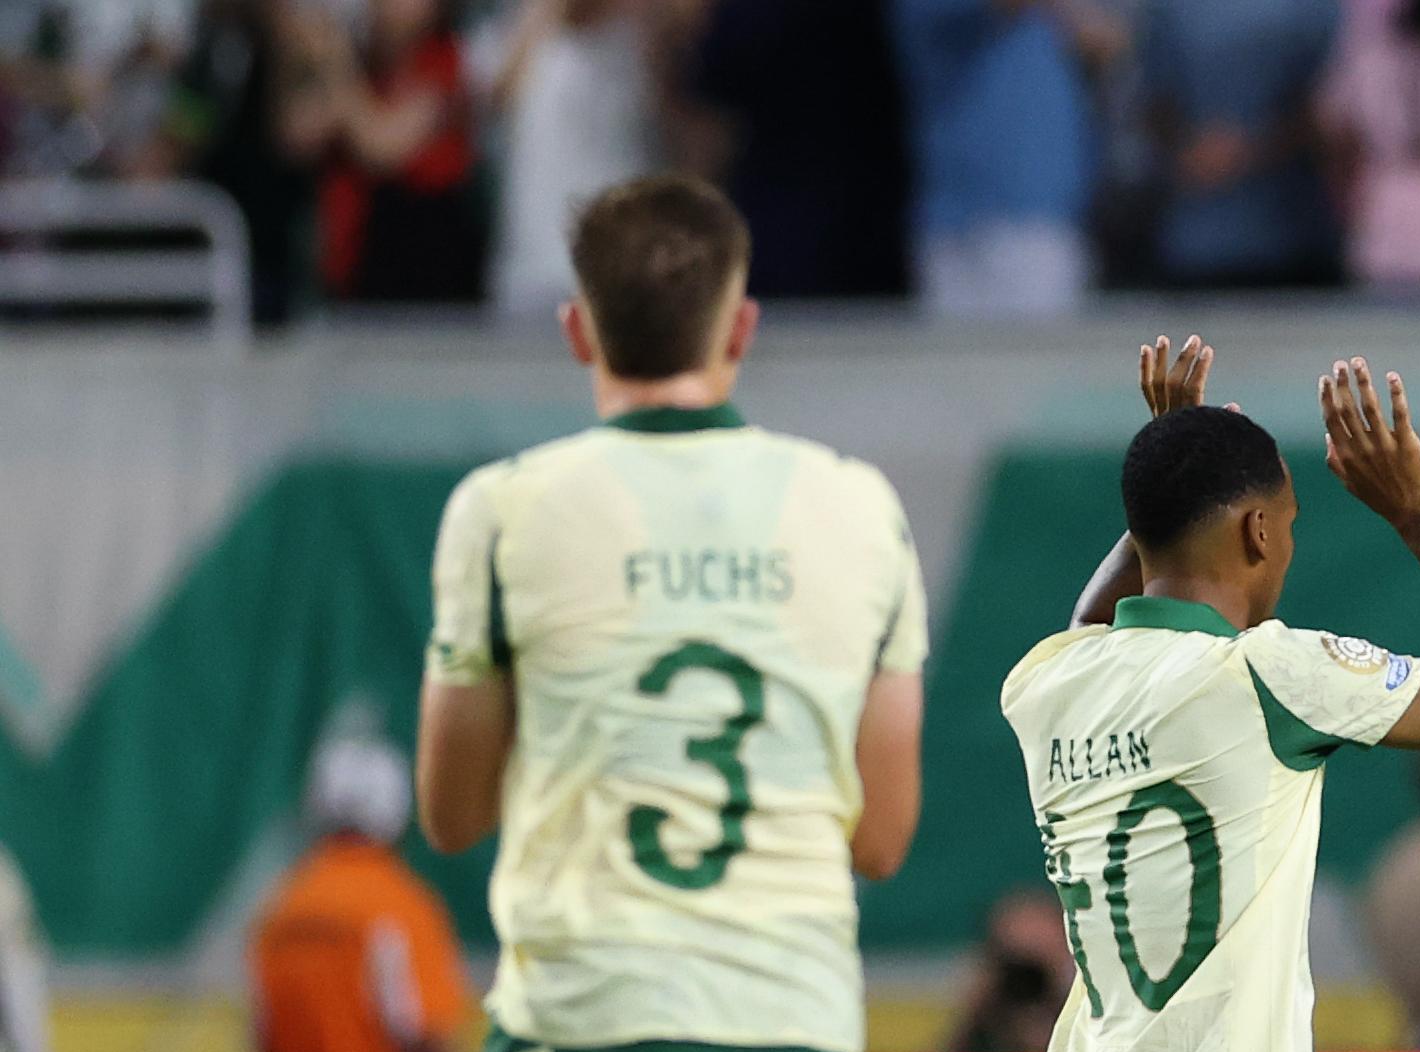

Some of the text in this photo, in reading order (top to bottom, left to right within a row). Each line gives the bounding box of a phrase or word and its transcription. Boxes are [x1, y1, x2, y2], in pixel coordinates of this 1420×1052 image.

[624, 549, 795, 602] FUCHS
[627, 638, 765, 890] 3
[1050, 730, 1151, 782] ALLAN
